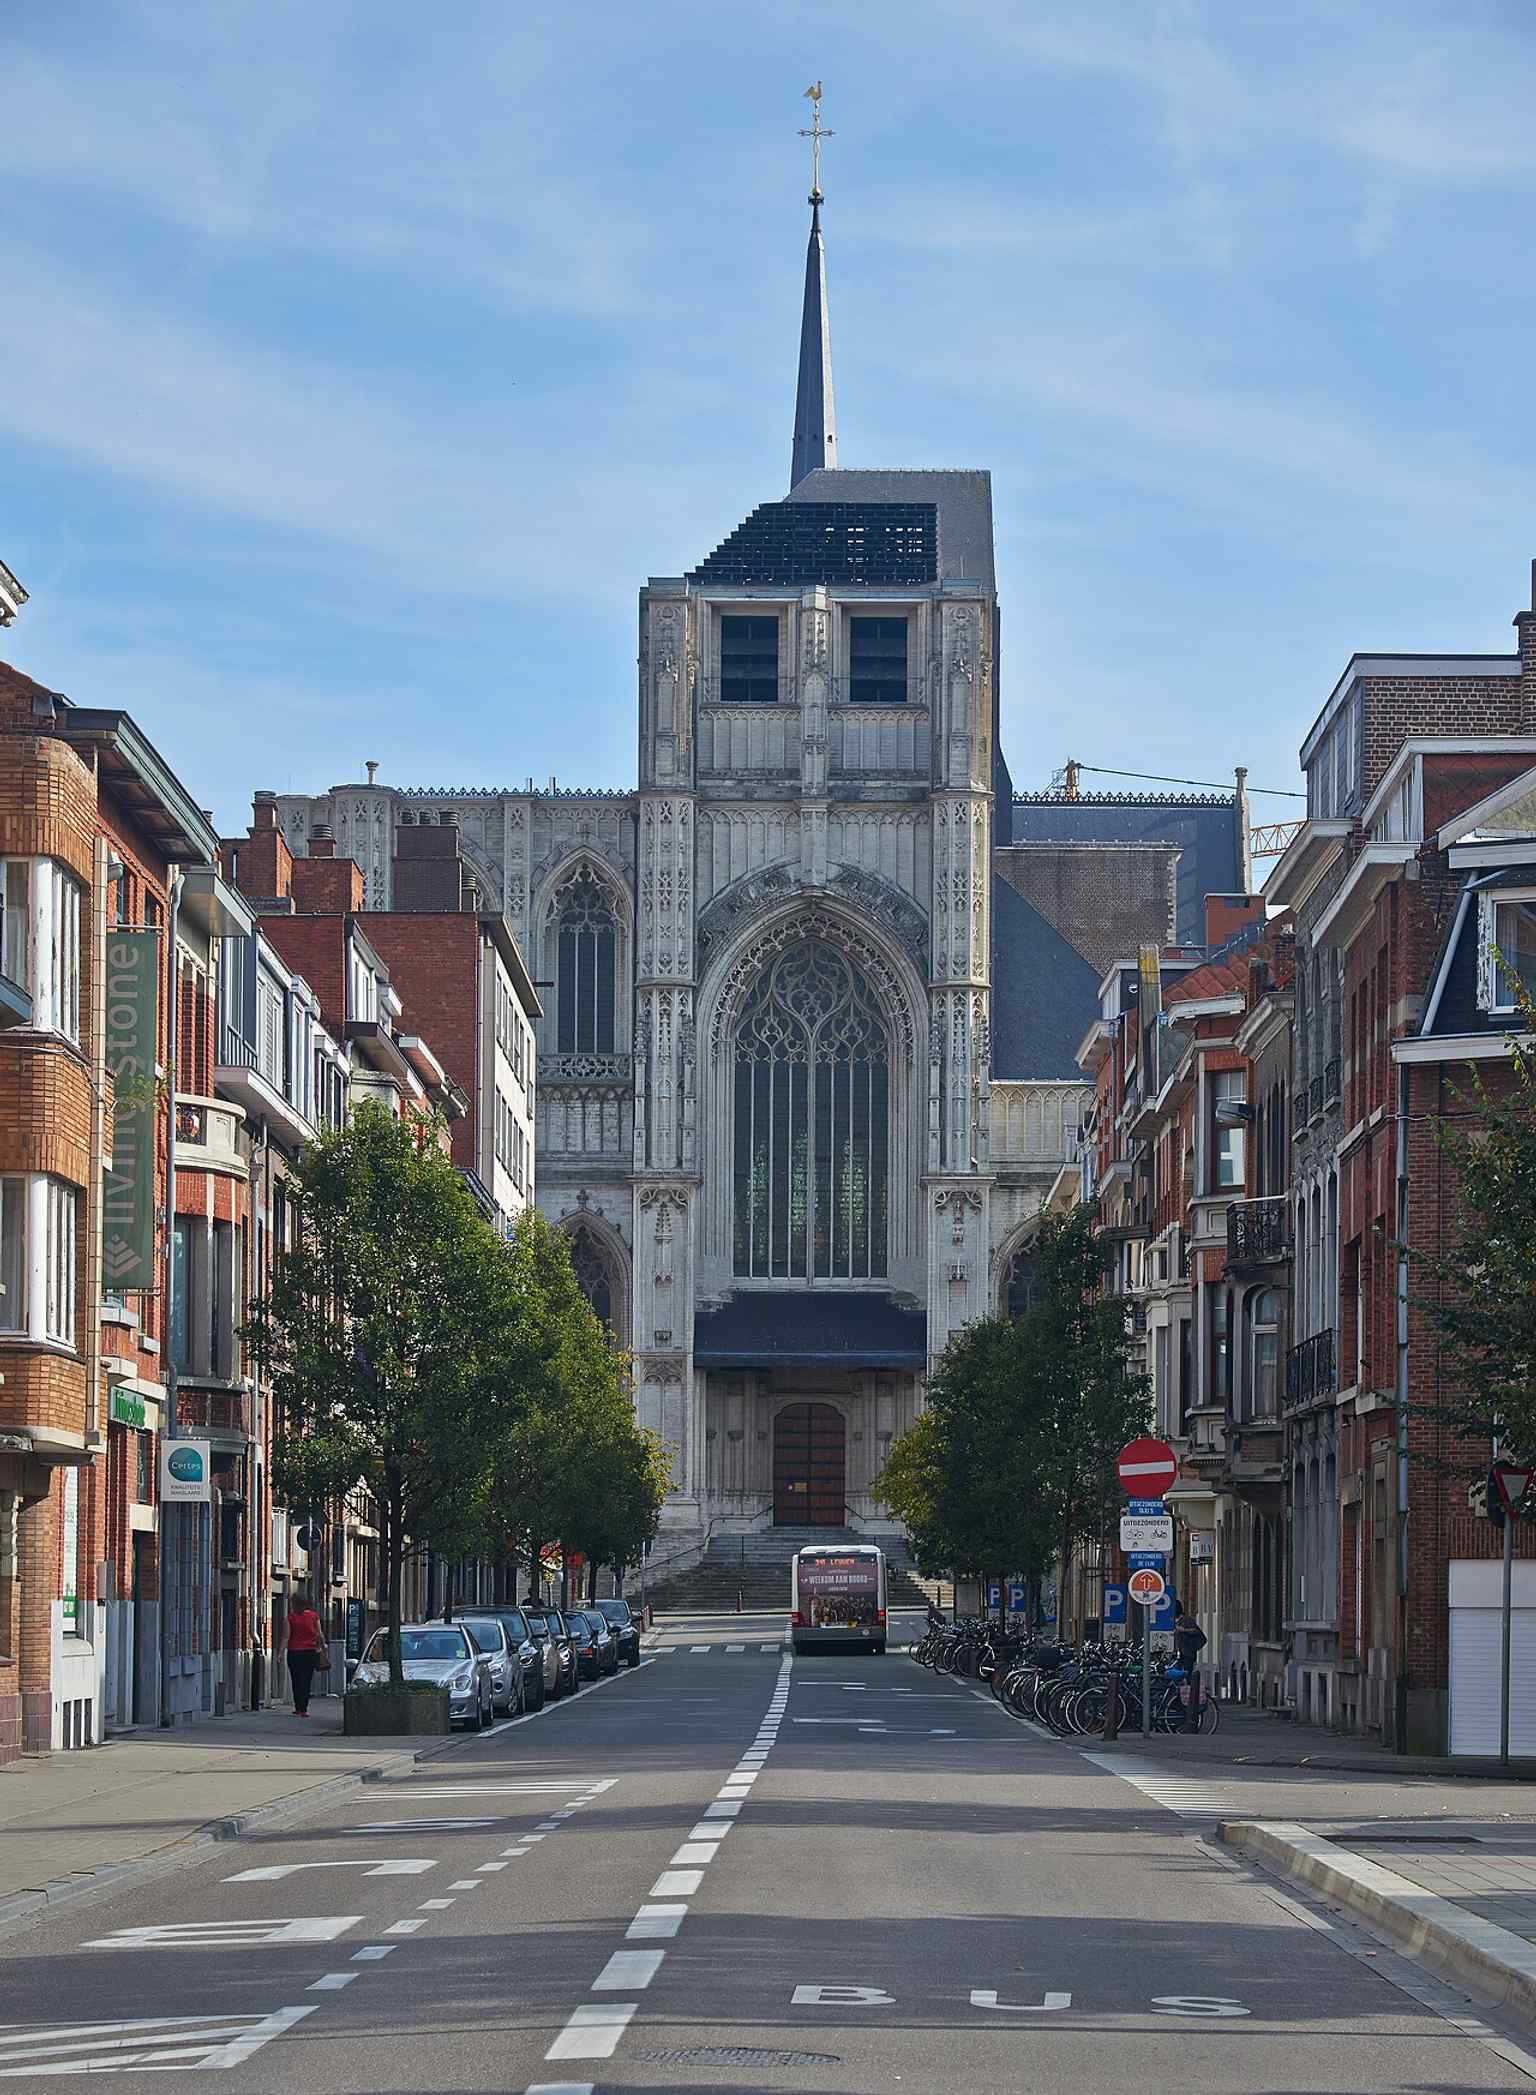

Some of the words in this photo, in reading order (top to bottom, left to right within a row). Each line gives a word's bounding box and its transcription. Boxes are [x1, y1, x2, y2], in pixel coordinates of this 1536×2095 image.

[990, 1587, 1000, 1605] P
[1011, 1588, 1024, 1608] P
[1104, 1590, 1123, 1617] P
[1150, 1593, 1171, 1624] P
[790, 1984, 1252, 2017] BUS
